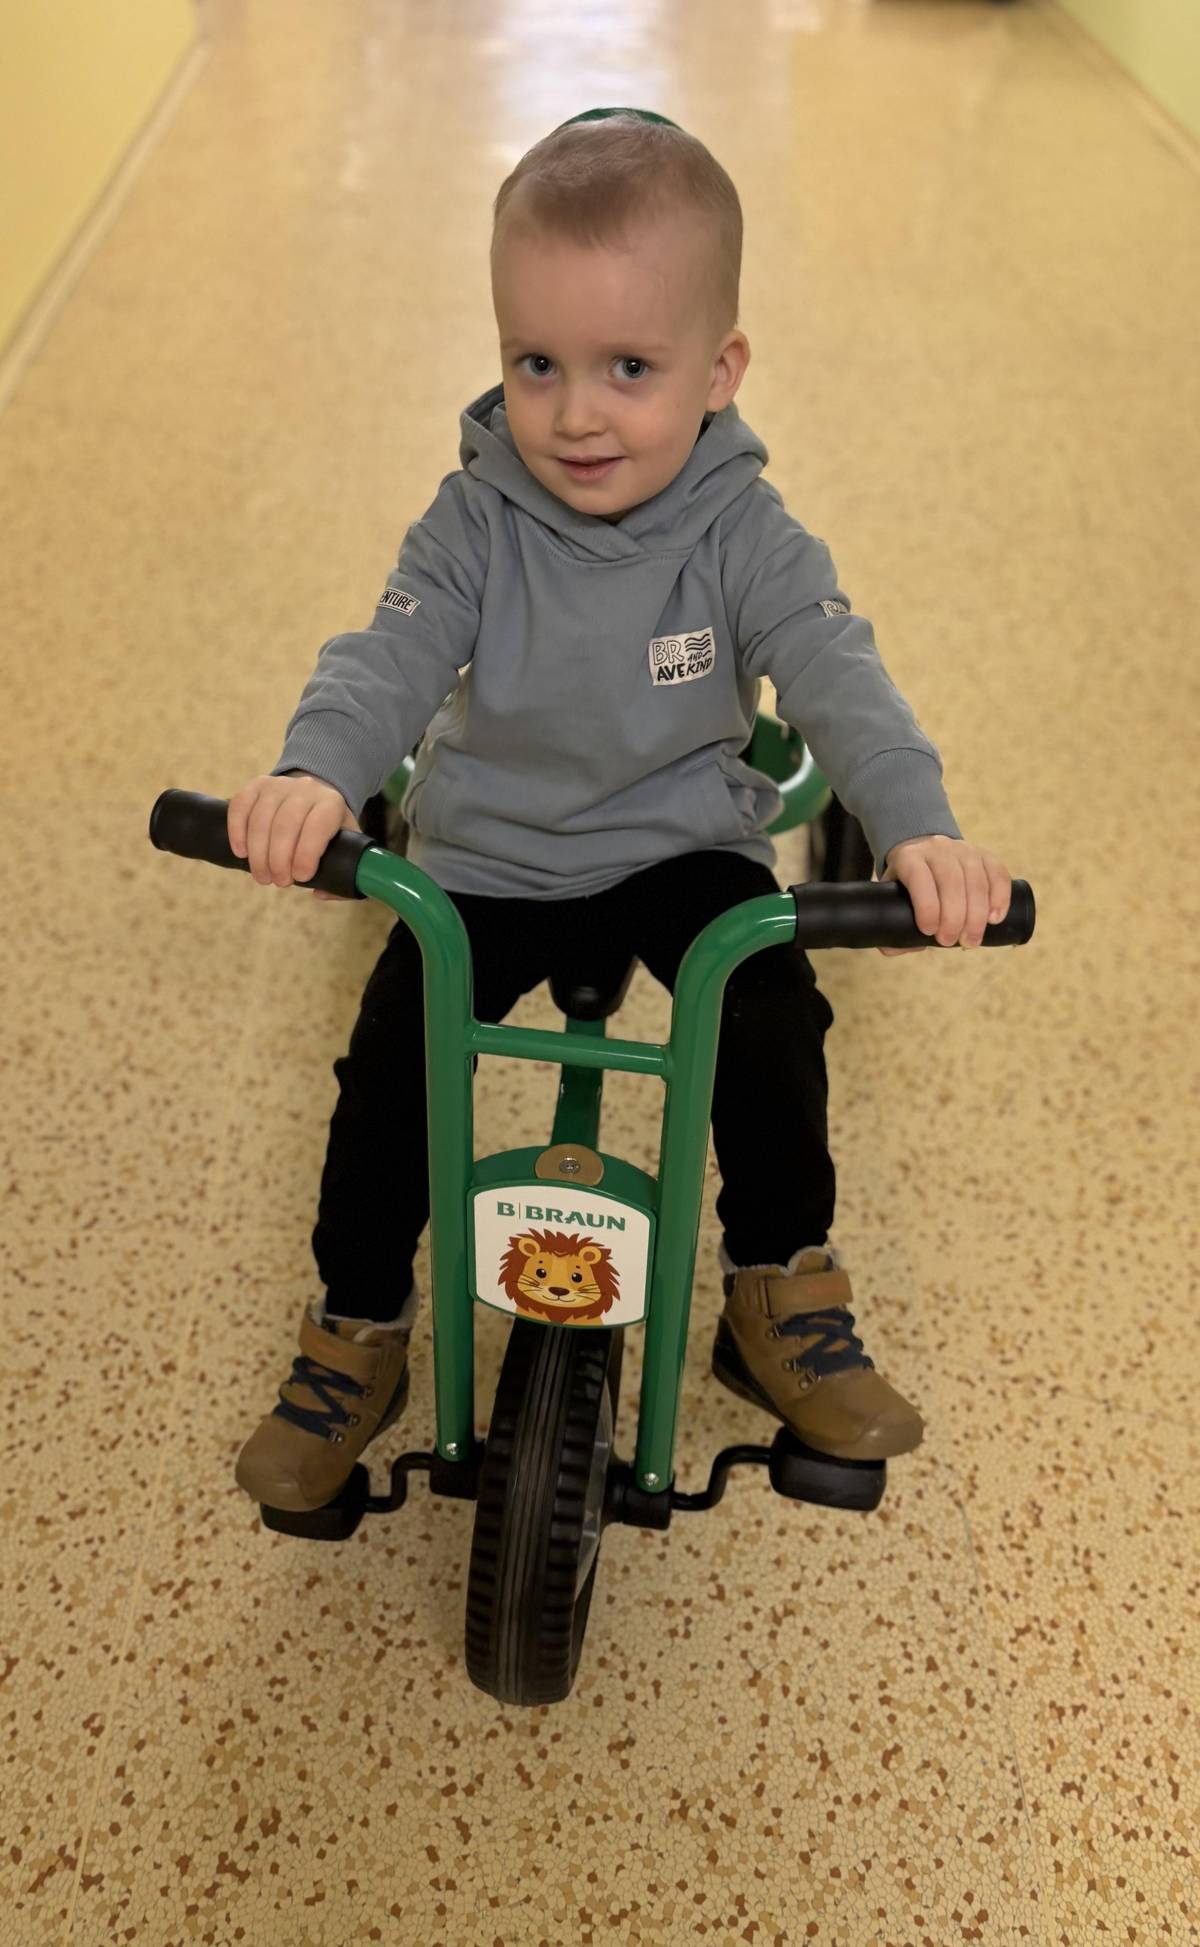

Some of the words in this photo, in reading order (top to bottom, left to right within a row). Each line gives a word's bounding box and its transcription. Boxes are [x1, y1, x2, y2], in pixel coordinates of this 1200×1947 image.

[652, 640, 685, 665] BR
[687, 651, 703, 663] AND
[657, 663, 685, 682] AVE
[686, 657, 713, 676] KIND
[525, 1205, 626, 1232] BRAUN
